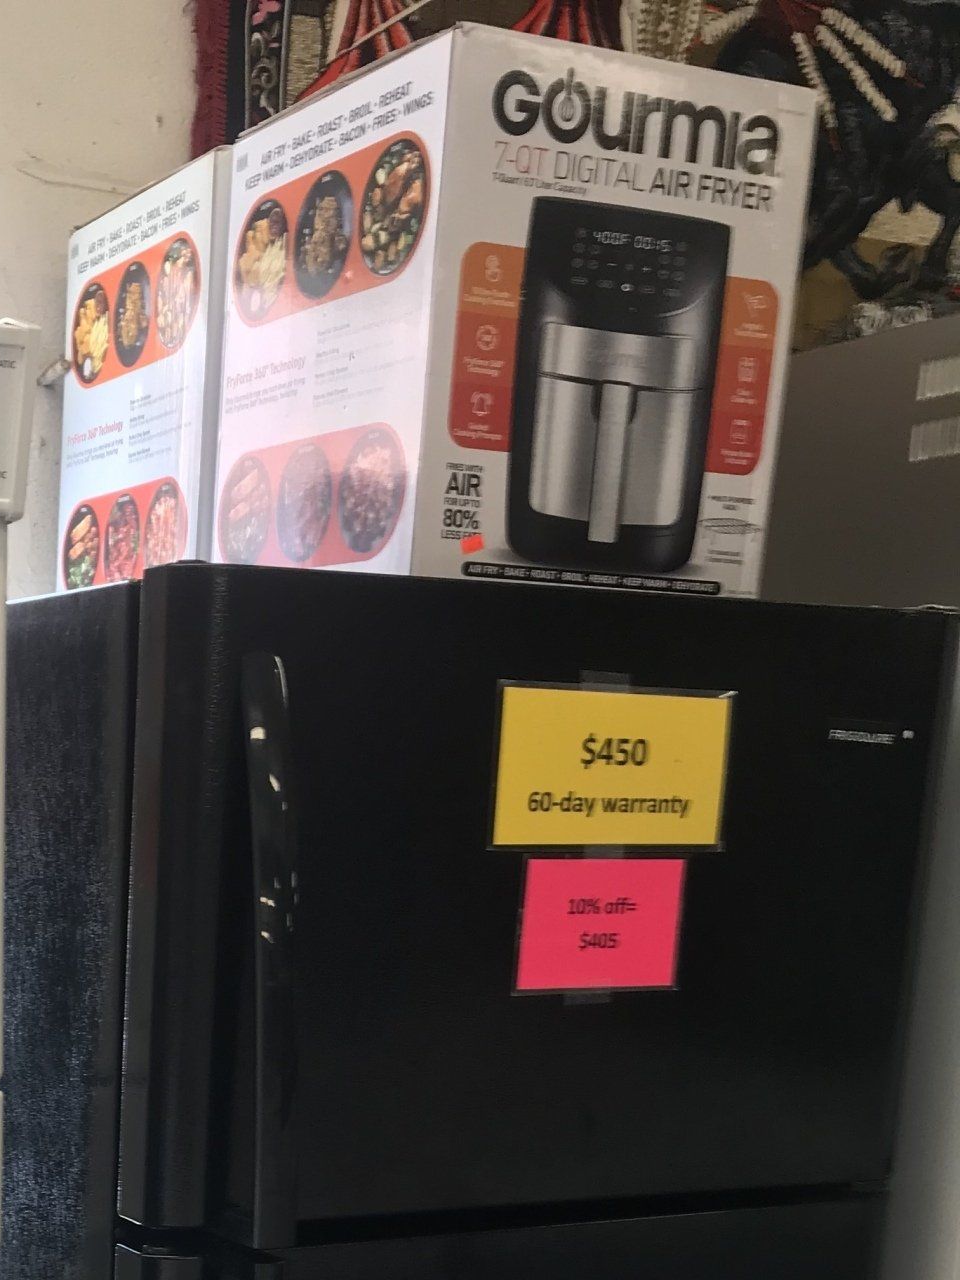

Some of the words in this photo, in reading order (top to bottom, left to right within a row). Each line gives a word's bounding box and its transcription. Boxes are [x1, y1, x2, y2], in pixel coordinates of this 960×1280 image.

[261, 151, 272, 166] AIR
[292, 129, 312, 151] BAKE
[316, 115, 344, 138] ROAST
[347, 102, 373, 124] BROIL
[378, 81, 414, 109] REHEAT
[290, 138, 335, 170] DEHYDRATE
[339, 123, 367, 148] BACON
[372, 108, 398, 132] FRIES
[403, 91, 436, 117] WINGS
[492, 67, 779, 177] Gourmia
[494, 141, 549, 174] 7-QT
[553, 150, 644, 191] DIGITAL
[649, 167, 690, 198] AIR
[696, 174, 775, 212] FRYER
[445, 472, 482, 497] AIR
[444, 497, 457, 506] FOR
[458, 498, 470, 507] UP
[471, 499, 481, 508] TO
[443, 508, 480, 529] 80%
[441, 529, 461, 540] LESS
[468, 564, 483, 574] AIR
[483, 565, 499, 575] FRY
[503, 567, 527, 577] BAKE
[530, 569, 557, 580] ROAST
[561, 572, 586, 582] BROIL
[580, 733, 650, 769] $450
[527, 790, 596, 818] 60-day
[601, 794, 692, 819] warranty
[567, 897, 601, 915] 10%
[604, 897, 639, 915] off=
[578, 932, 620, 951] $405
